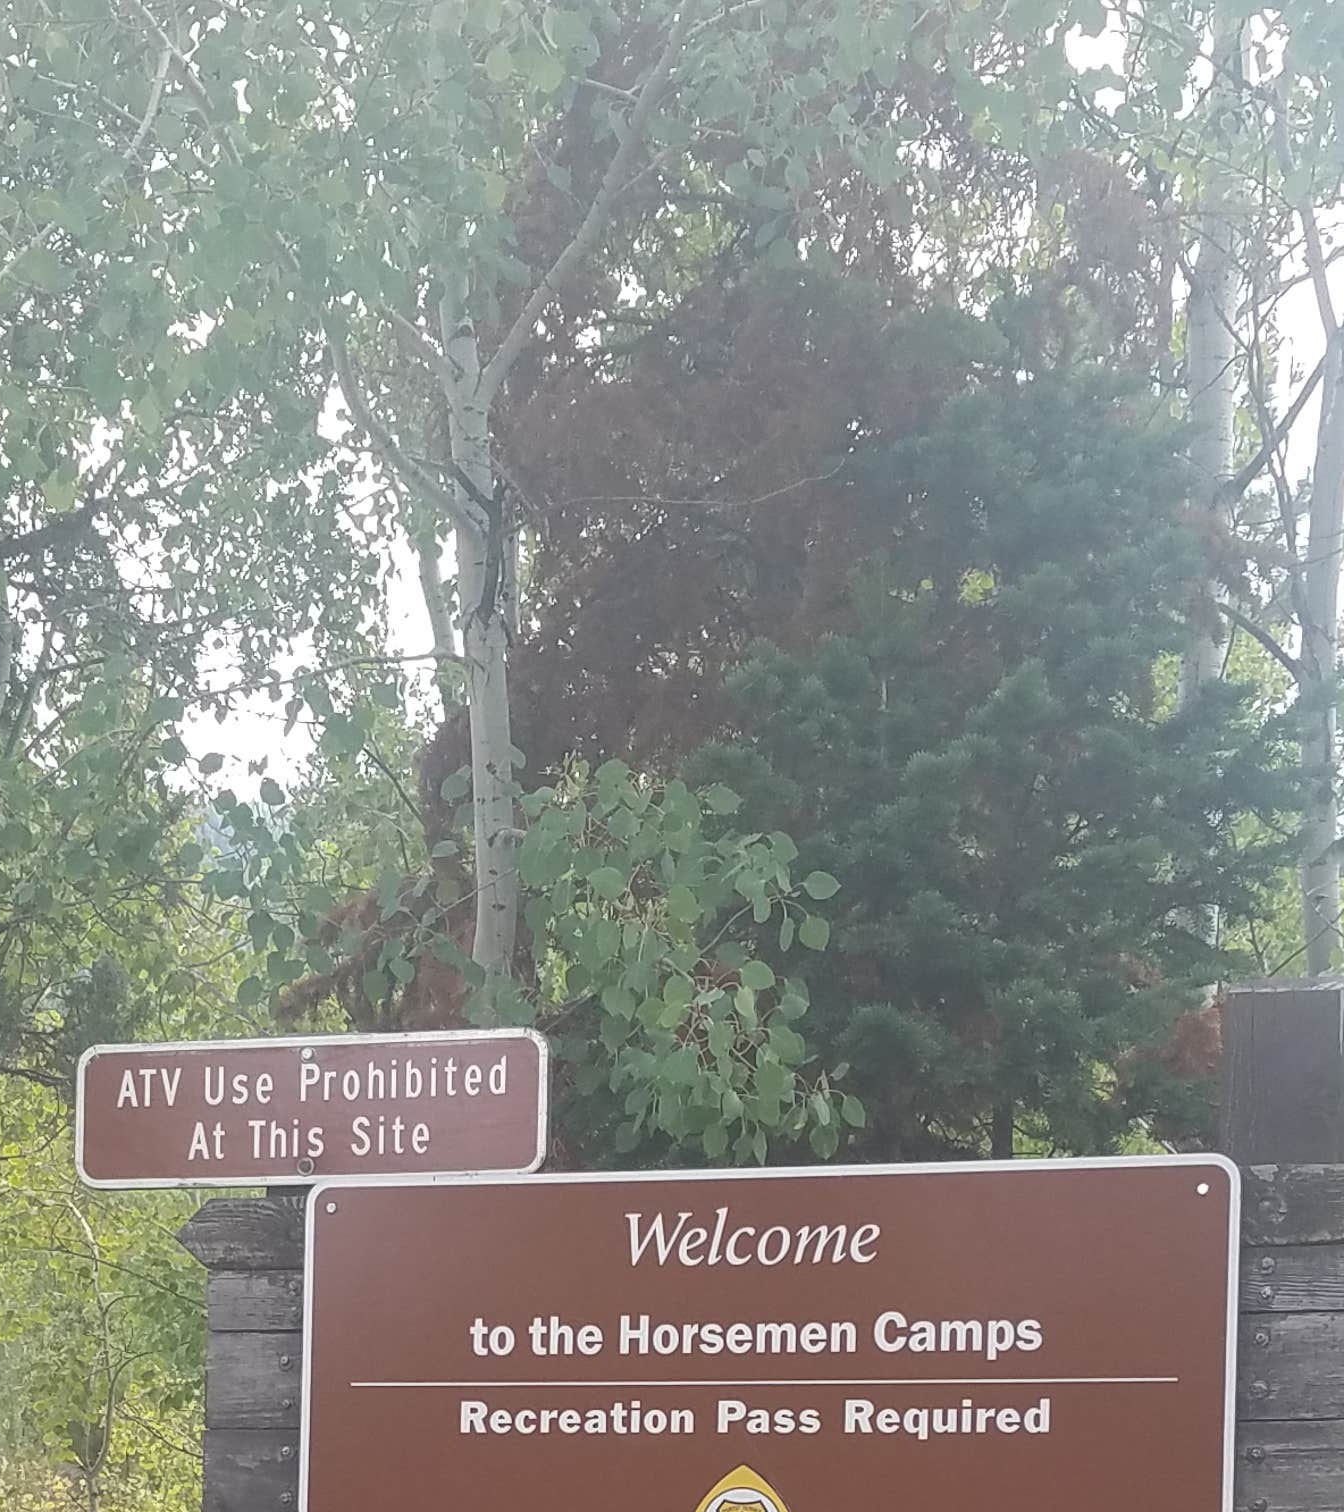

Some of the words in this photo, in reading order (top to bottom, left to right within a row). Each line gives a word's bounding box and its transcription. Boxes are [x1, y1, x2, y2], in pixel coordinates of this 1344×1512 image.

[117, 1067, 182, 1108] ATV
[204, 1066, 273, 1106] Use
[300, 1055, 507, 1102] Prohibited
[188, 1121, 226, 1161] At
[248, 1118, 325, 1159] This
[350, 1115, 430, 1156] Site
[624, 1206, 881, 1267] Welcome
[469, 1317, 515, 1356] to
[528, 1315, 603, 1356] the
[619, 1314, 857, 1355] Horsemen
[873, 1311, 1043, 1361] Camps
[460, 1400, 694, 1435] Recreation
[717, 1400, 821, 1434] Pass
[844, 1398, 1051, 1440] Required
